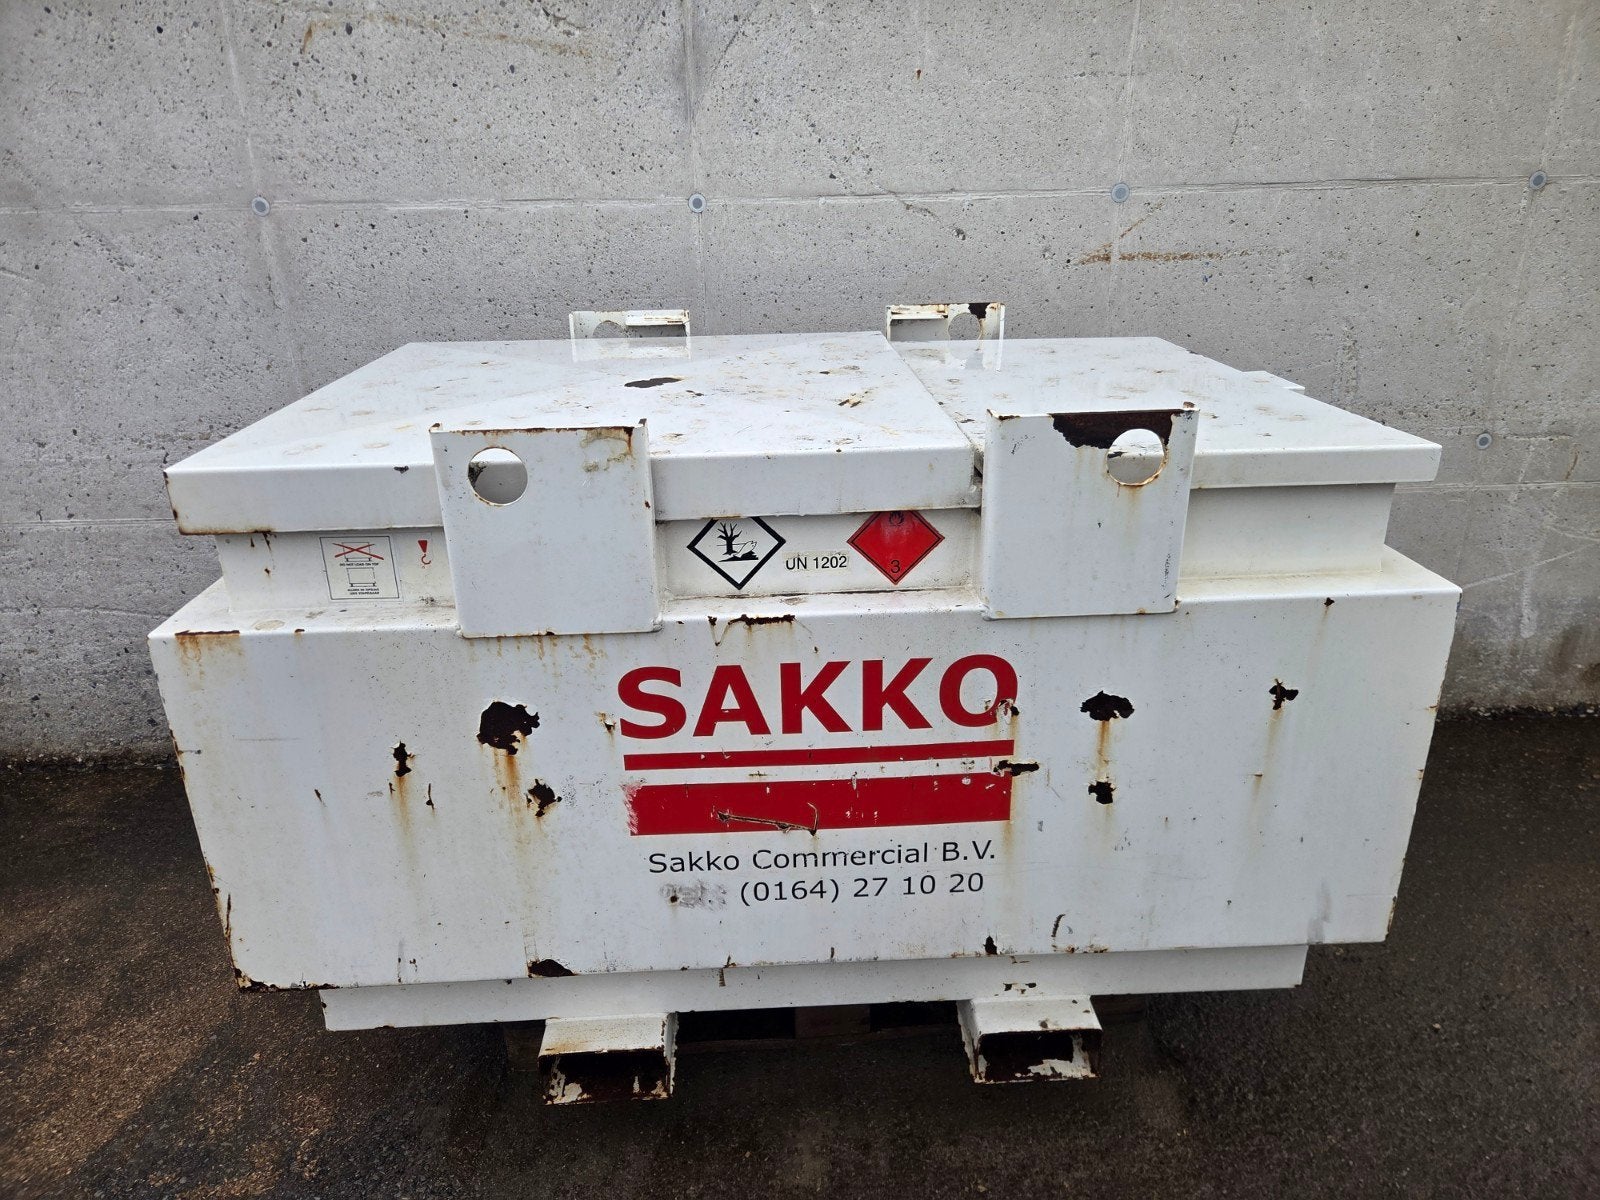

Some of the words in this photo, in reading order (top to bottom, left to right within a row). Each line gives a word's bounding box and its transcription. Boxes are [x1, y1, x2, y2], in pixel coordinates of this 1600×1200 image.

[785, 557, 808, 571] UN
[813, 555, 847, 569] 1202
[890, 559, 901, 574] 3
[617, 654, 1018, 740] SAKKO
[648, 850, 740, 874] Sakko
[752, 841, 928, 870] Commercial
[942, 839, 995, 862] B.V.
[740, 878, 839, 907] (0164)
[853, 877, 888, 898] 27
[902, 874, 936, 896] 10
[949, 872, 984, 893] 20
